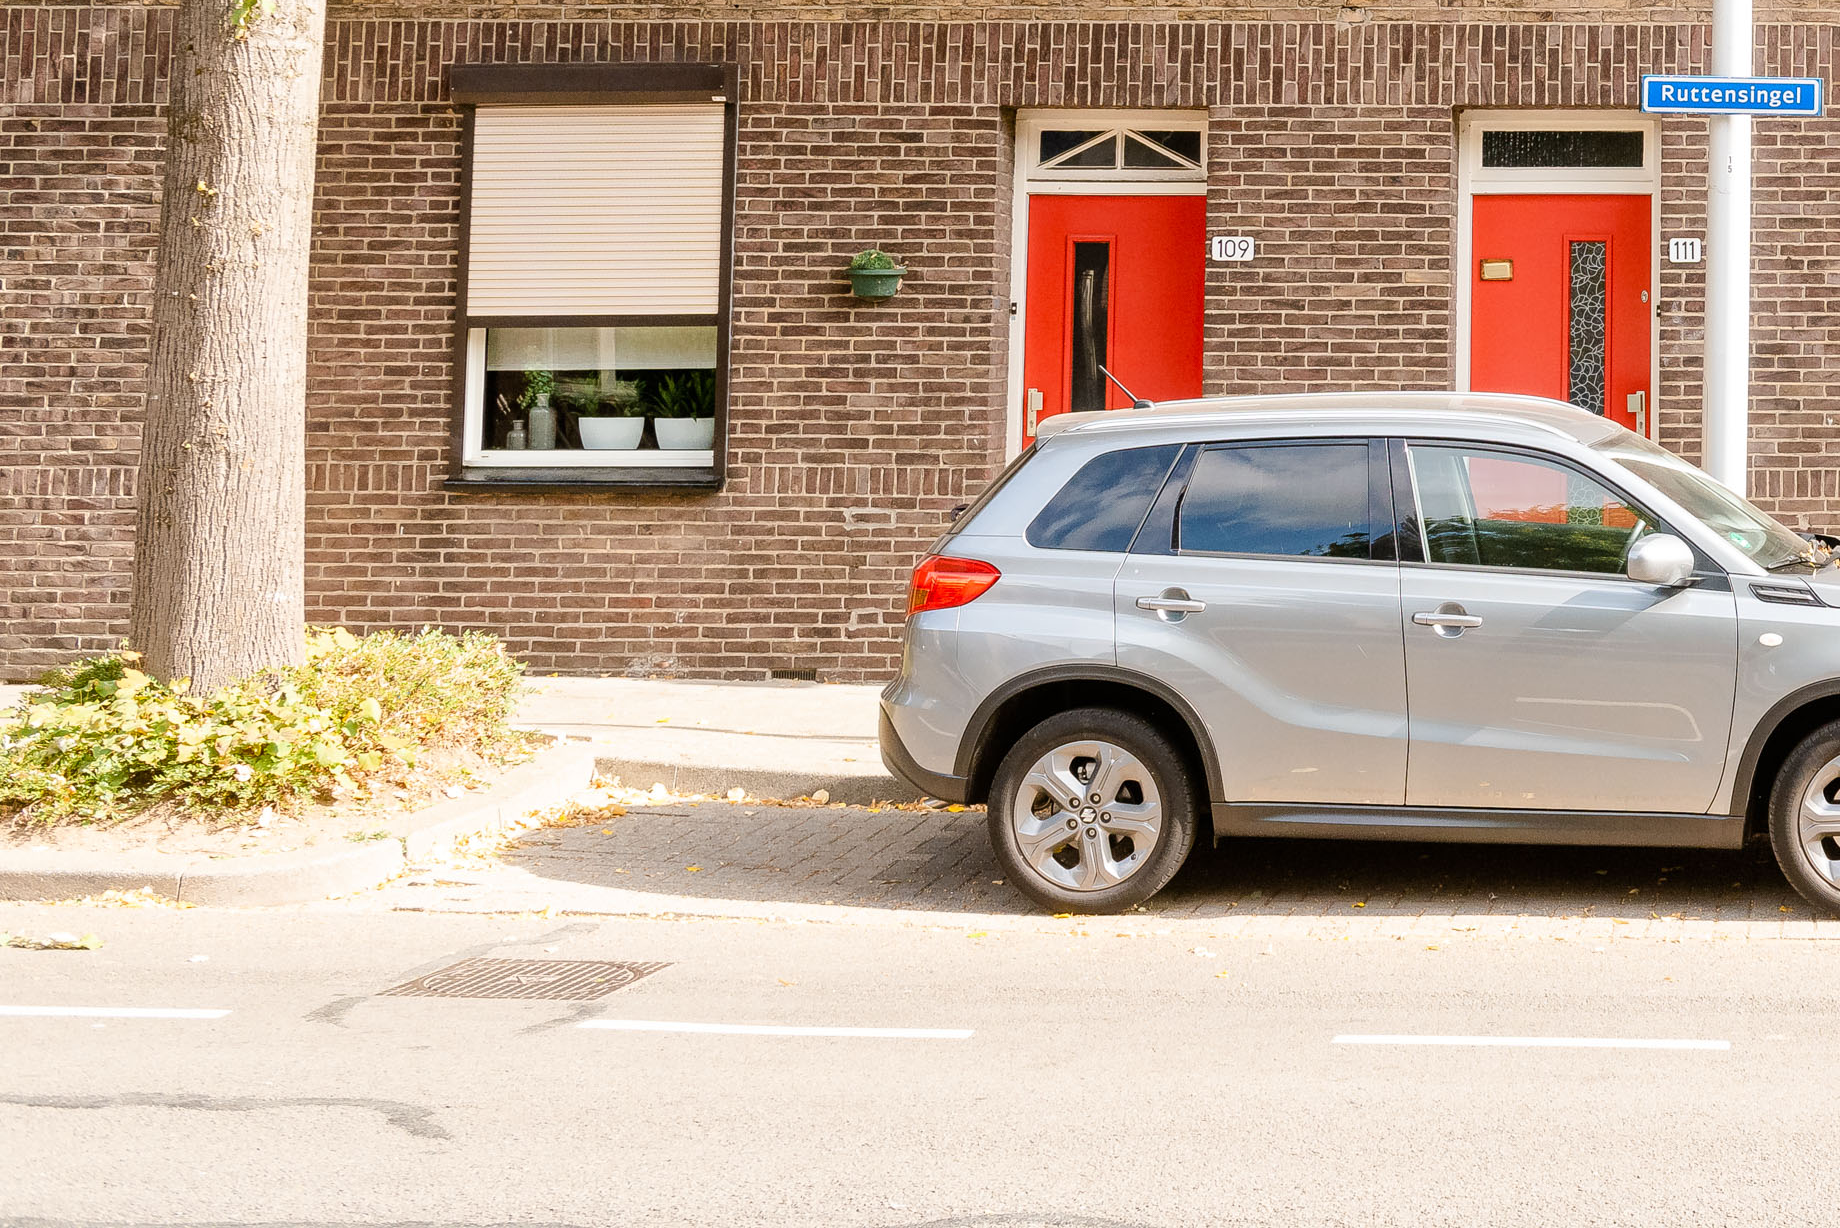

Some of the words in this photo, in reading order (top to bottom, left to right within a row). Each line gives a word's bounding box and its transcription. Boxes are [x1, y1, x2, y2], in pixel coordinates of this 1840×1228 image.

[1661, 84, 1801, 107] Ruttensingel
[1217, 239, 1250, 258] 109
[1674, 241, 1695, 260] 111
